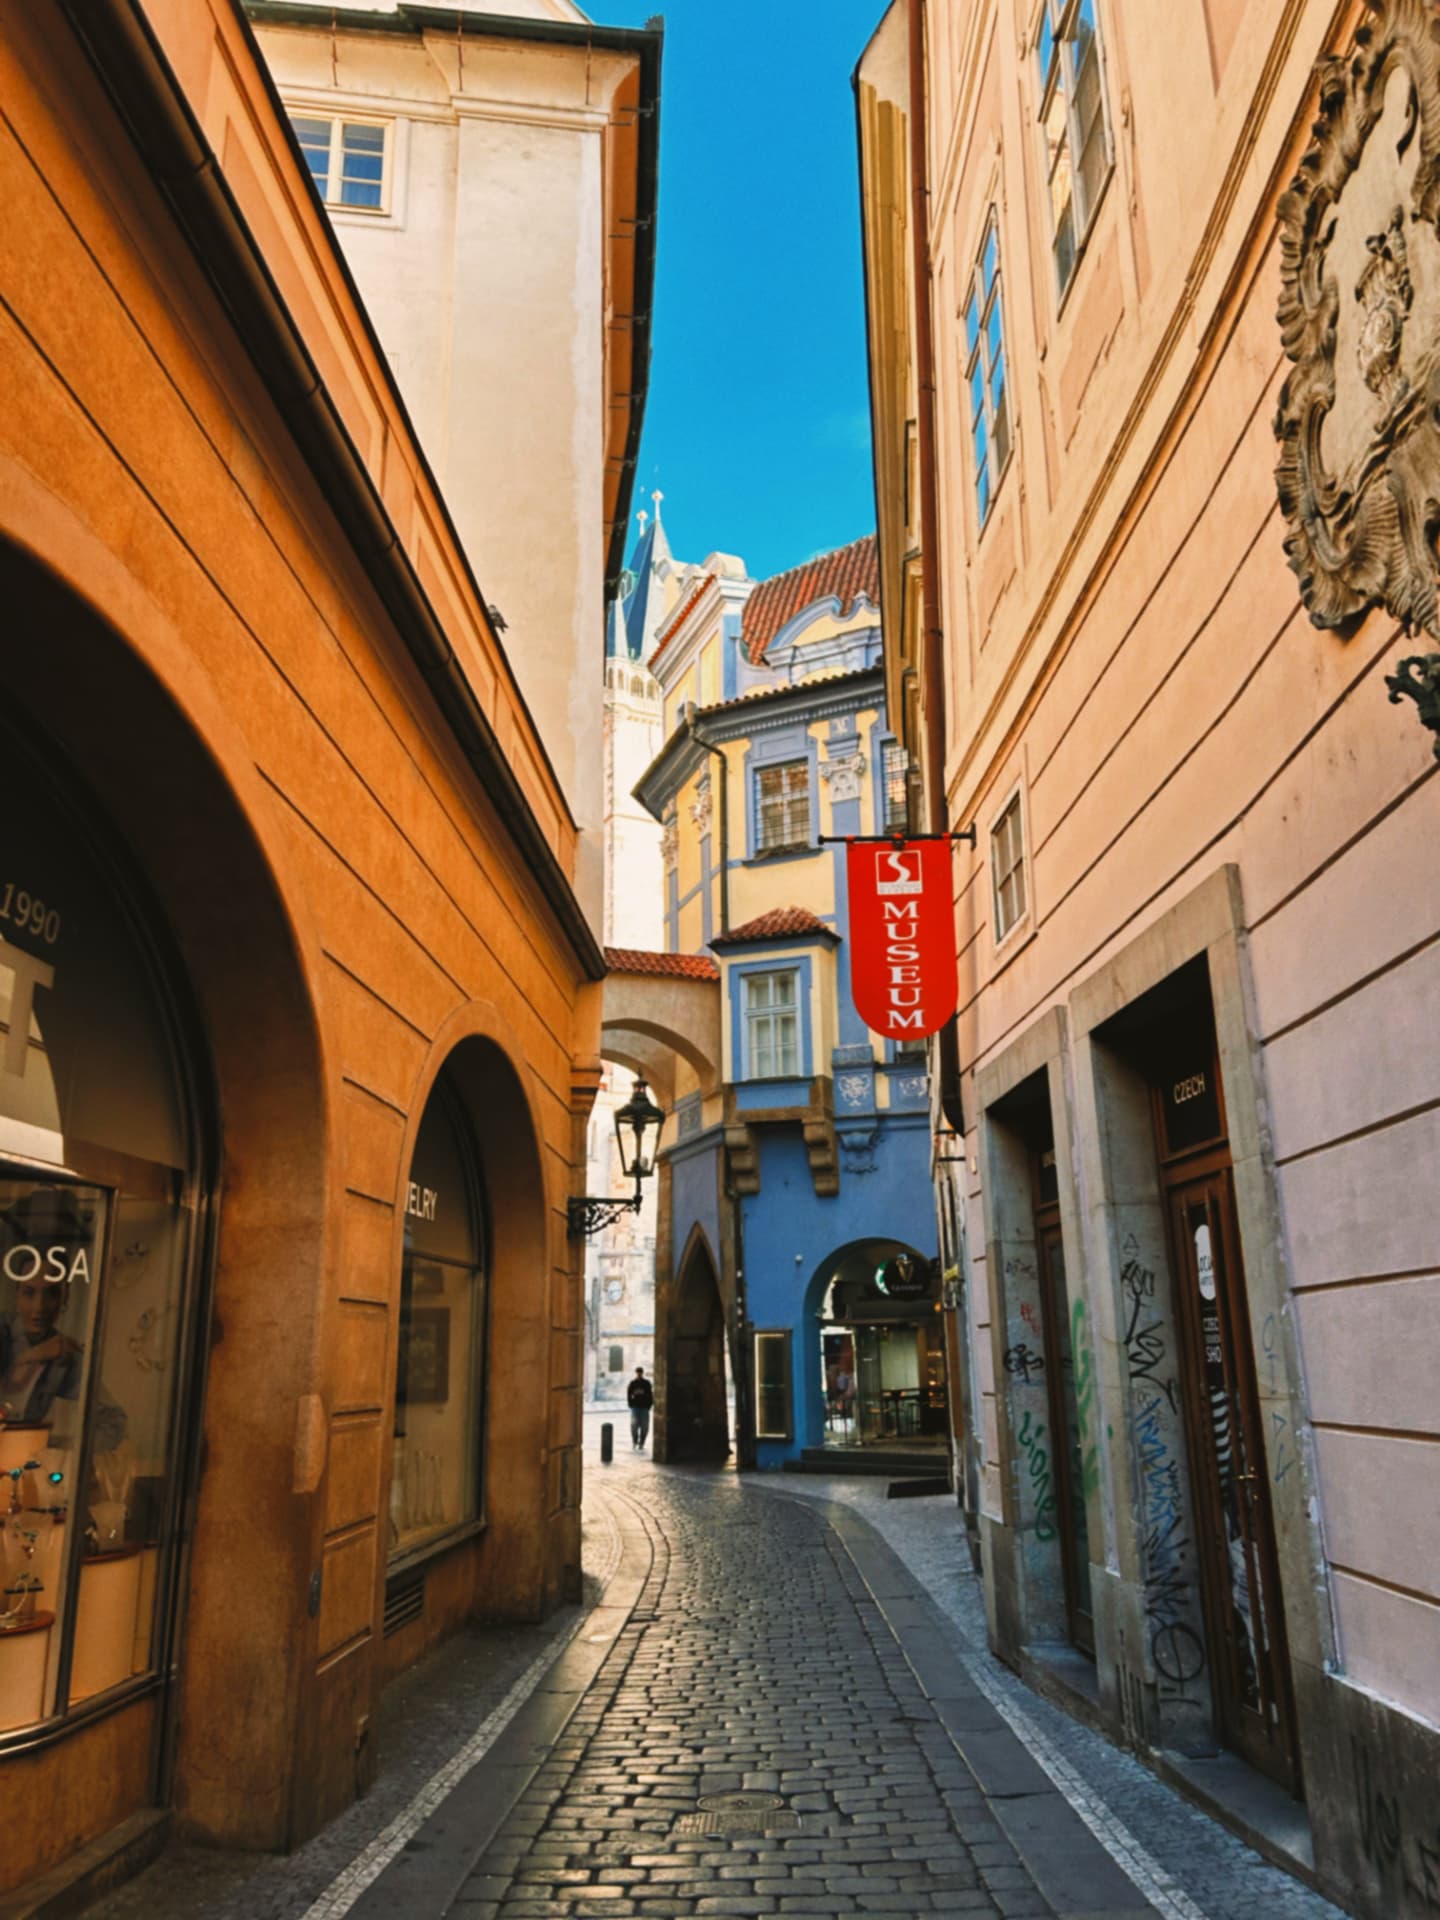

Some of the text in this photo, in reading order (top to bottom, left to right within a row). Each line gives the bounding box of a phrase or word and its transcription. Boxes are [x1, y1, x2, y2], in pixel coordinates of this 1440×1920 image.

[0, 883, 61, 944] 1990
[882, 900, 926, 1029] MUSEUM
[1173, 1072, 1206, 1105] CZECH
[3, 1244, 91, 1285] OSA
